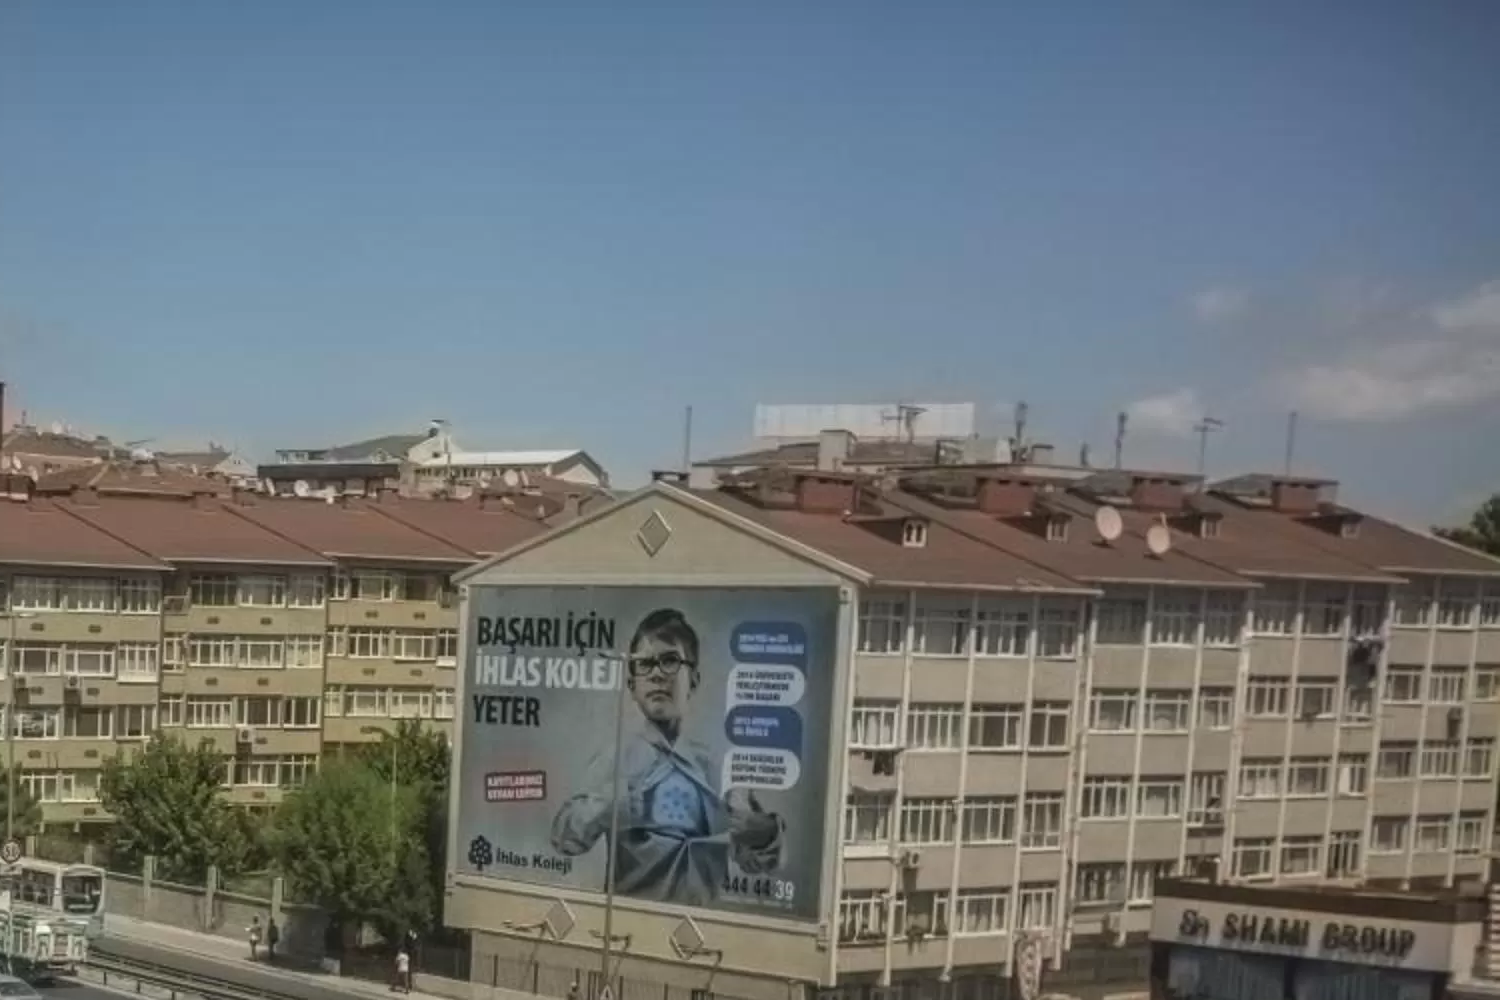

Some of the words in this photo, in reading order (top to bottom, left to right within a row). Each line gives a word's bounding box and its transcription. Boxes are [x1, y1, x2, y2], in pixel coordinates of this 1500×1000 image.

[476, 616, 561, 654] BAŞARI
[566, 611, 615, 657] İÇİN
[474, 648, 542, 687] İHLAS
[473, 695, 541, 728] YETER
[532, 852, 573, 875] Koleji
[775, 879, 795, 901] 39
[1321, 921, 1416, 961] GROUP
